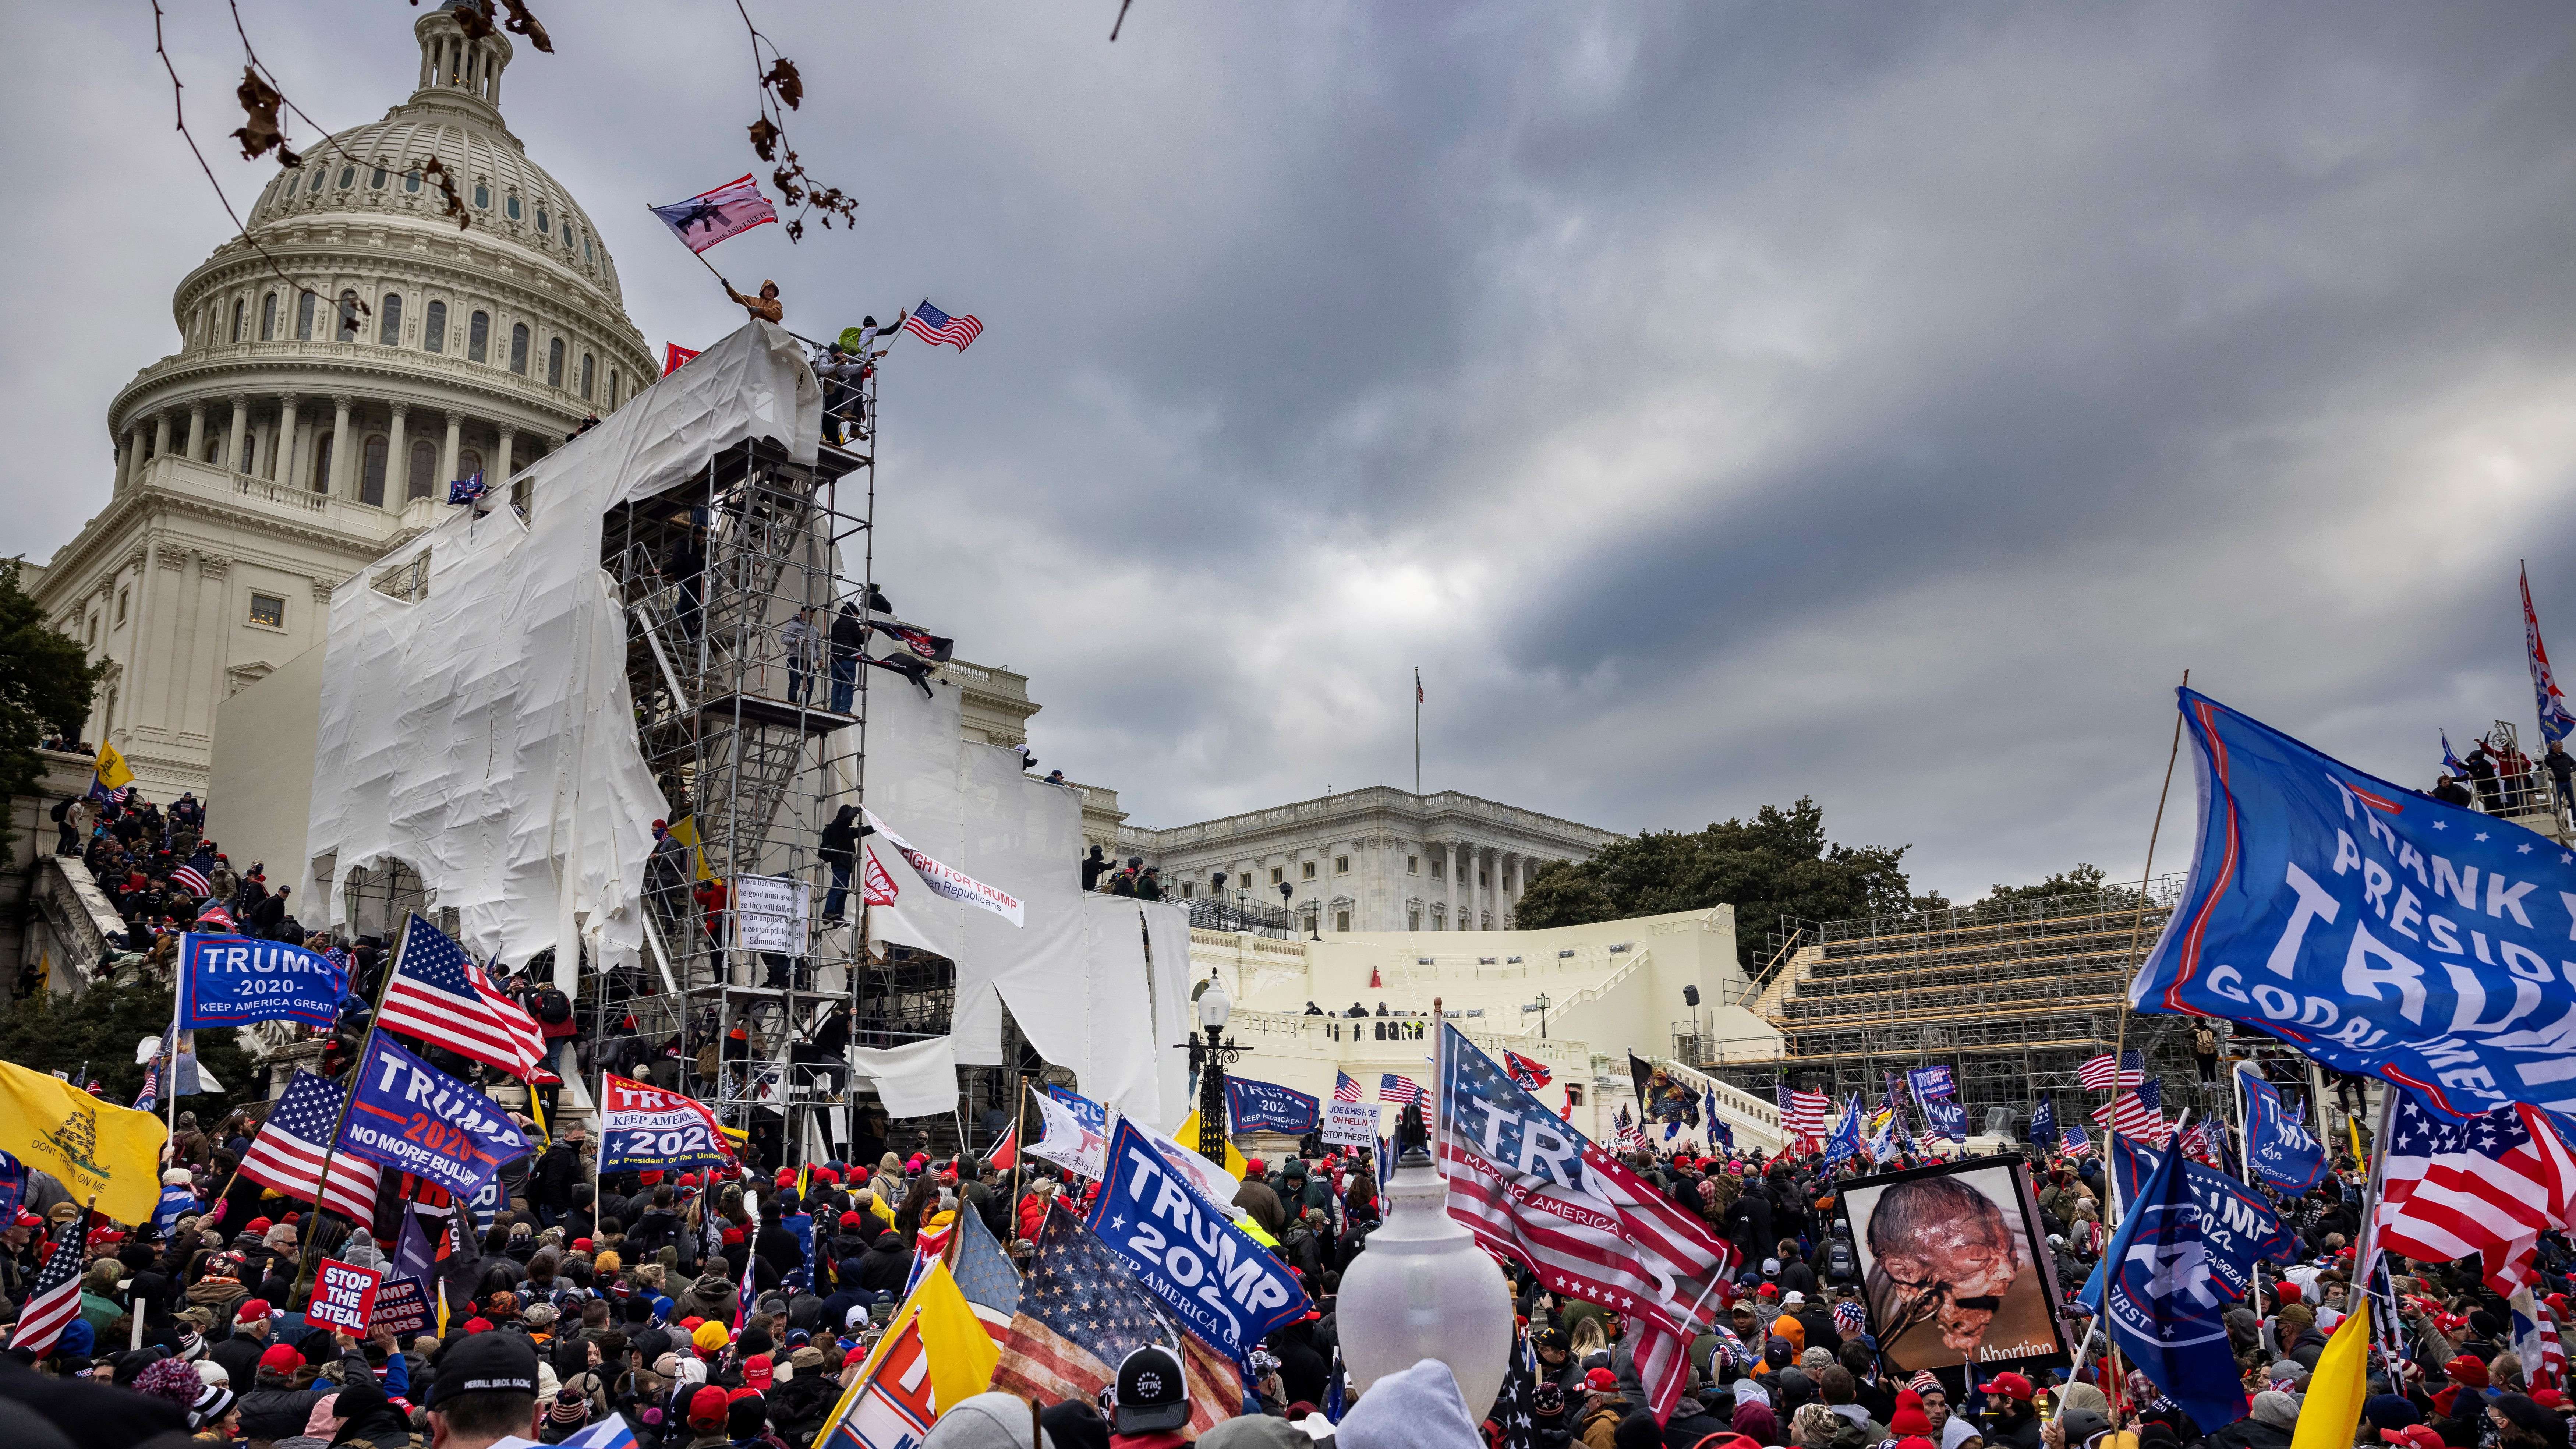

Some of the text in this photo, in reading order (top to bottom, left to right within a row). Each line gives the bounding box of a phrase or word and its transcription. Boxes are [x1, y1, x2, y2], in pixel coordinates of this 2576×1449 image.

[728, 225, 742, 236] AND
[742, 215, 759, 228] TAKE
[738, 877, 756, 886] When
[902, 848, 1017, 909] FIGHT FOR TRUMP
[748, 891, 763, 899] good
[943, 881, 1001, 911] Republicans
[2333, 827, 2554, 982] PRESID
[749, 902, 762, 911] they
[759, 915, 783, 924] unpitied
[748, 927, 786, 936] contemptible
[203, 947, 331, 976] TRUMP
[233, 979, 303, 996] -2020-
[2207, 964, 2339, 1029] GOD
[200, 998, 333, 1013] KEEP AMERICA GREAT!
[1913, 1069, 1946, 1088] TRUMP
[379, 1051, 525, 1147] TRUMP
[613, 1112, 698, 1126] KEEP AMERIC
[1043, 1100, 1054, 1135] GOD WE
[1058, 1097, 1105, 1122] TRU
[1242, 1114, 1260, 1123] KEEP
[1262, 1113, 1289, 1123] AMERICA
[1329, 1106, 1343, 1114] JOE
[1344, 1117, 1362, 1126] HELL
[349, 1123, 378, 1144] NO
[377, 1133, 432, 1165] MORE
[403, 1112, 473, 1161] 2020
[1323, 1130, 1370, 1142] STOP THE STE
[1601, 1137, 1631, 1146] FGHT
[32, 1139, 106, 1193] DONT TREAD ON ME
[1464, 1153, 1619, 1236] MAKING AMERICA
[1128, 1146, 1289, 1315] TRUMP
[325, 1267, 372, 1291] STOP
[327, 1286, 362, 1309] THE
[374, 1283, 415, 1302] UMP
[1140, 1271, 1217, 1334] AMERICA
[311, 1301, 364, 1329] STEAL
[369, 1302, 424, 1322] MORE
[388, 1317, 423, 1332] ARS
[1981, 1340, 2053, 1363] Abortion
[464, 1379, 491, 1389] MERRILL
[492, 1379, 512, 1388] BROS.
[1142, 1381, 1158, 1390] 1776
[2152, 1400, 2167, 1412] 020
